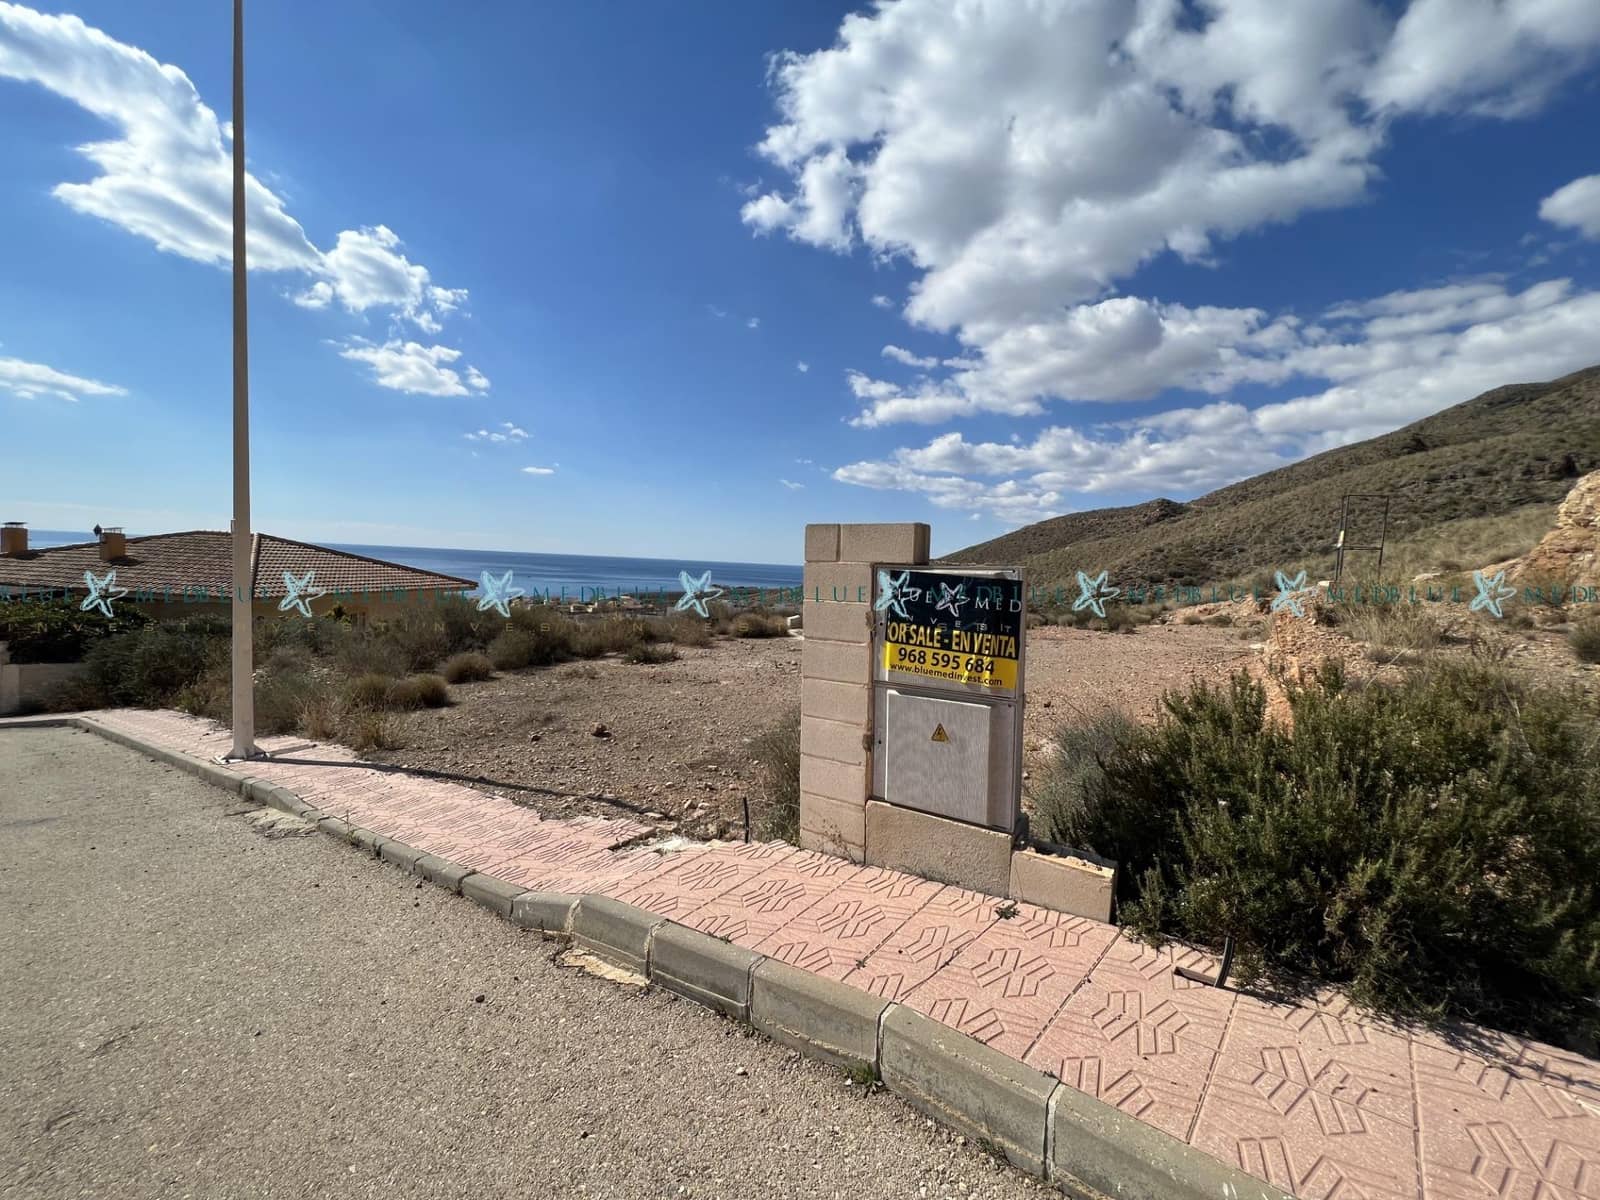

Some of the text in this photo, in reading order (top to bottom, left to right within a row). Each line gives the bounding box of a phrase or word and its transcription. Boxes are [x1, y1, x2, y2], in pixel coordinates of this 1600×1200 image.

[974, 596, 1022, 613] MED
[888, 621, 907, 643] OR
[909, 623, 942, 649] SALE
[951, 629, 971, 652] EN
[973, 632, 1017, 659] VENTA
[898, 647, 995, 676] 968 595 684
